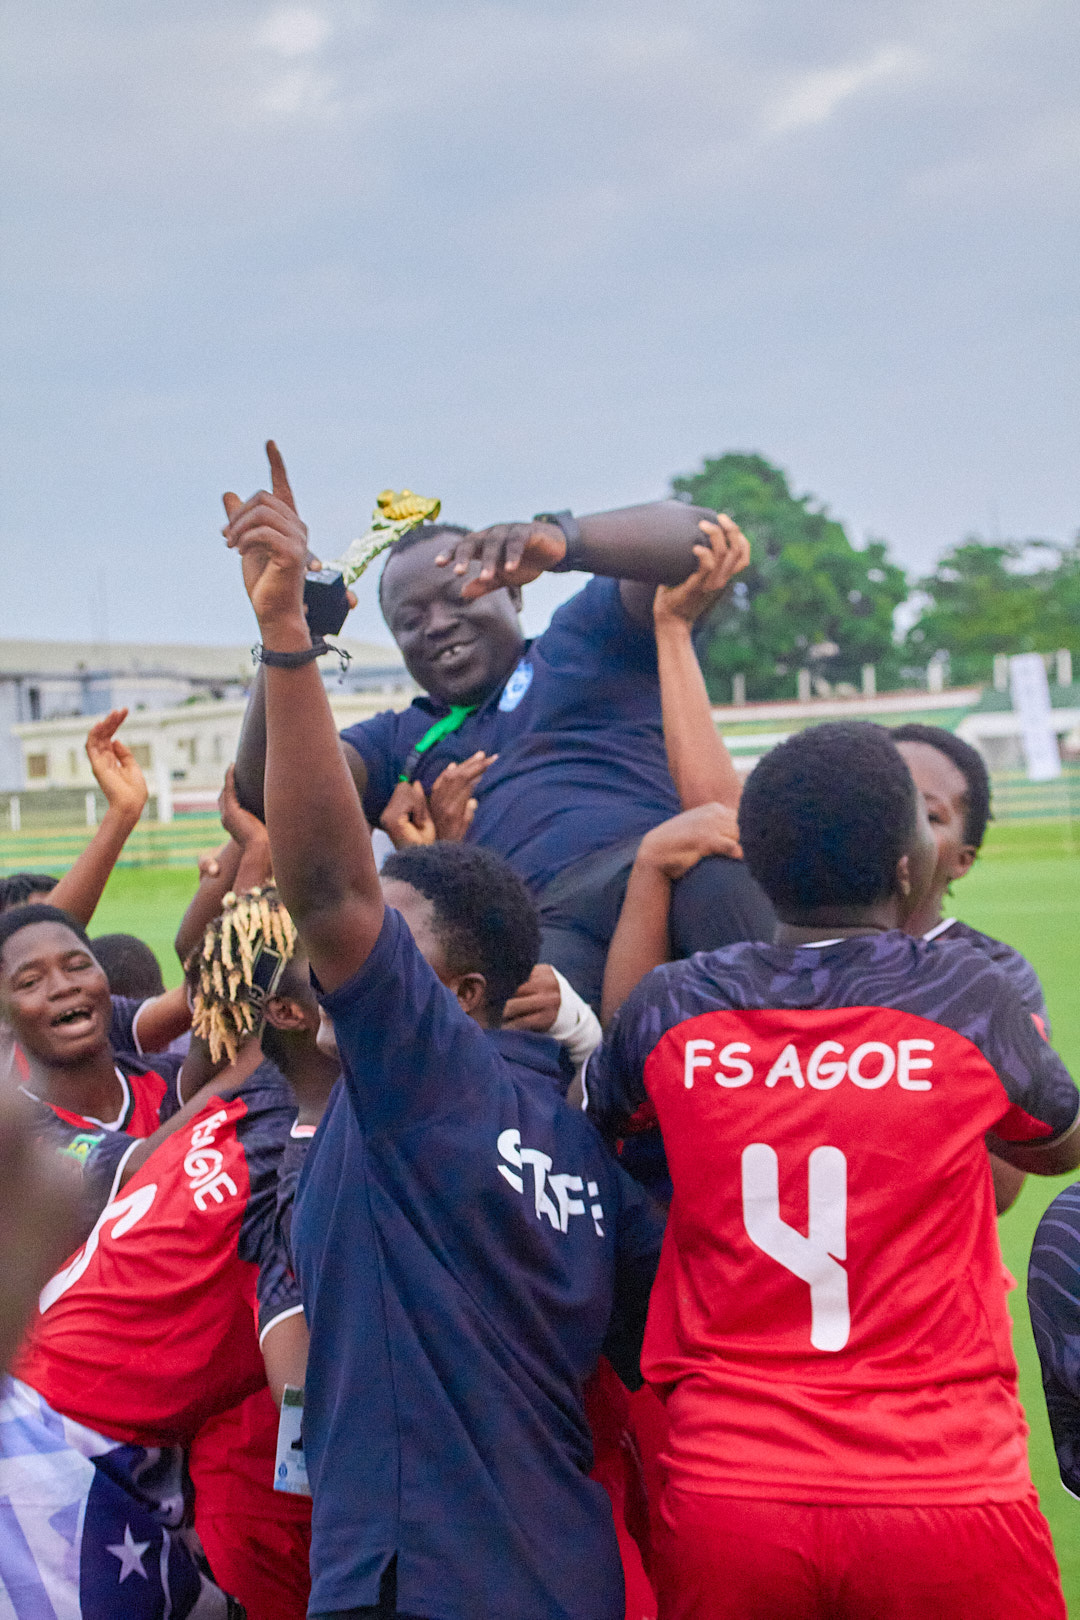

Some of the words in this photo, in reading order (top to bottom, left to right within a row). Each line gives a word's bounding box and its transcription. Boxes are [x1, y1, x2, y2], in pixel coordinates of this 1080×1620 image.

[684, 1039, 754, 1089] FS
[764, 1038, 936, 1091] AGOE
[741, 1142, 851, 1353] 4
